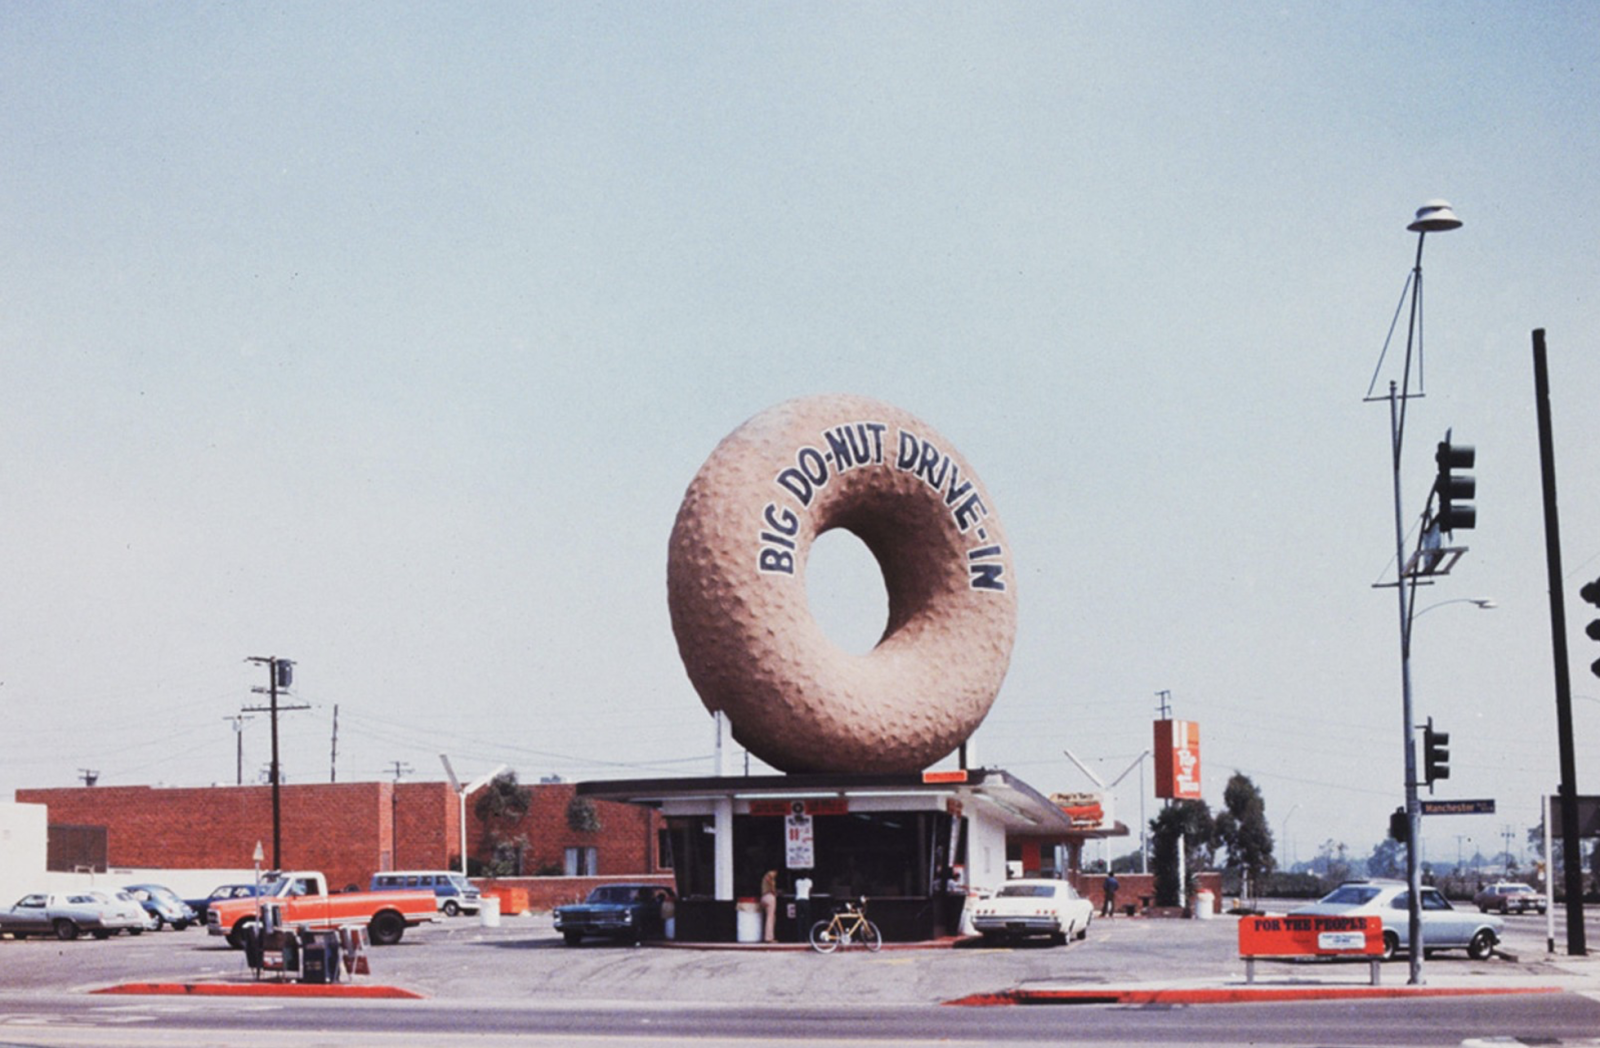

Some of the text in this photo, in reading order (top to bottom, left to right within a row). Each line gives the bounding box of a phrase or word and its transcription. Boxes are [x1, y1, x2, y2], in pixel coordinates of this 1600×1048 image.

[759, 423, 1006, 592] BIG DO-NUT DRIVE-IN
[1425, 803, 1475, 812] Manchester
[1254, 918, 1368, 931] FOR THE PEOPLE
